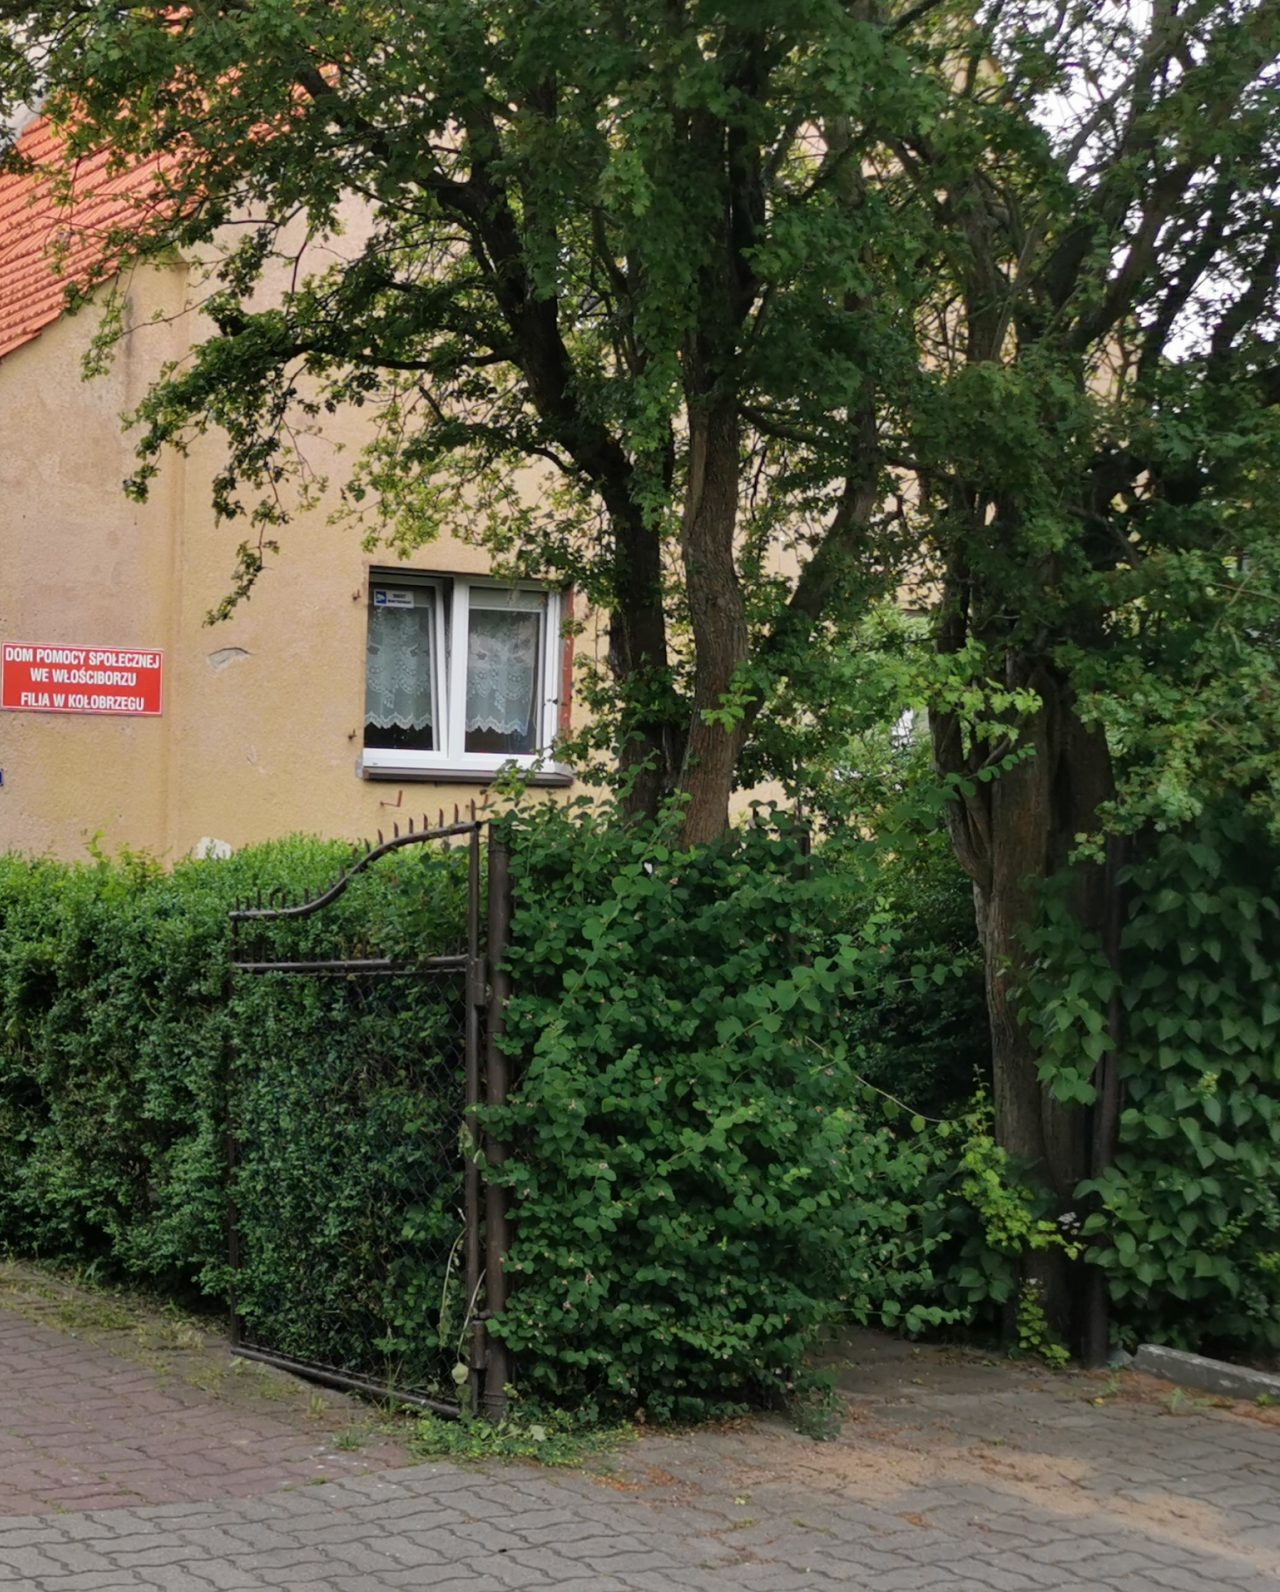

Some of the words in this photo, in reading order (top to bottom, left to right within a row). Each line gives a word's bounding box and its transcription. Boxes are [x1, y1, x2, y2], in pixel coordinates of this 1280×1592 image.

[5, 647, 32, 662] DOM
[36, 649, 86, 665] POMOCY
[89, 652, 159, 669] SPOŁECZNEJ
[30, 668, 48, 682] WE
[52, 668, 136, 687] WŁOŚCIBORZU
[21, 692, 50, 706] FILIA
[53, 694, 65, 707] W
[68, 694, 144, 711] KOŁOBRZEGU
